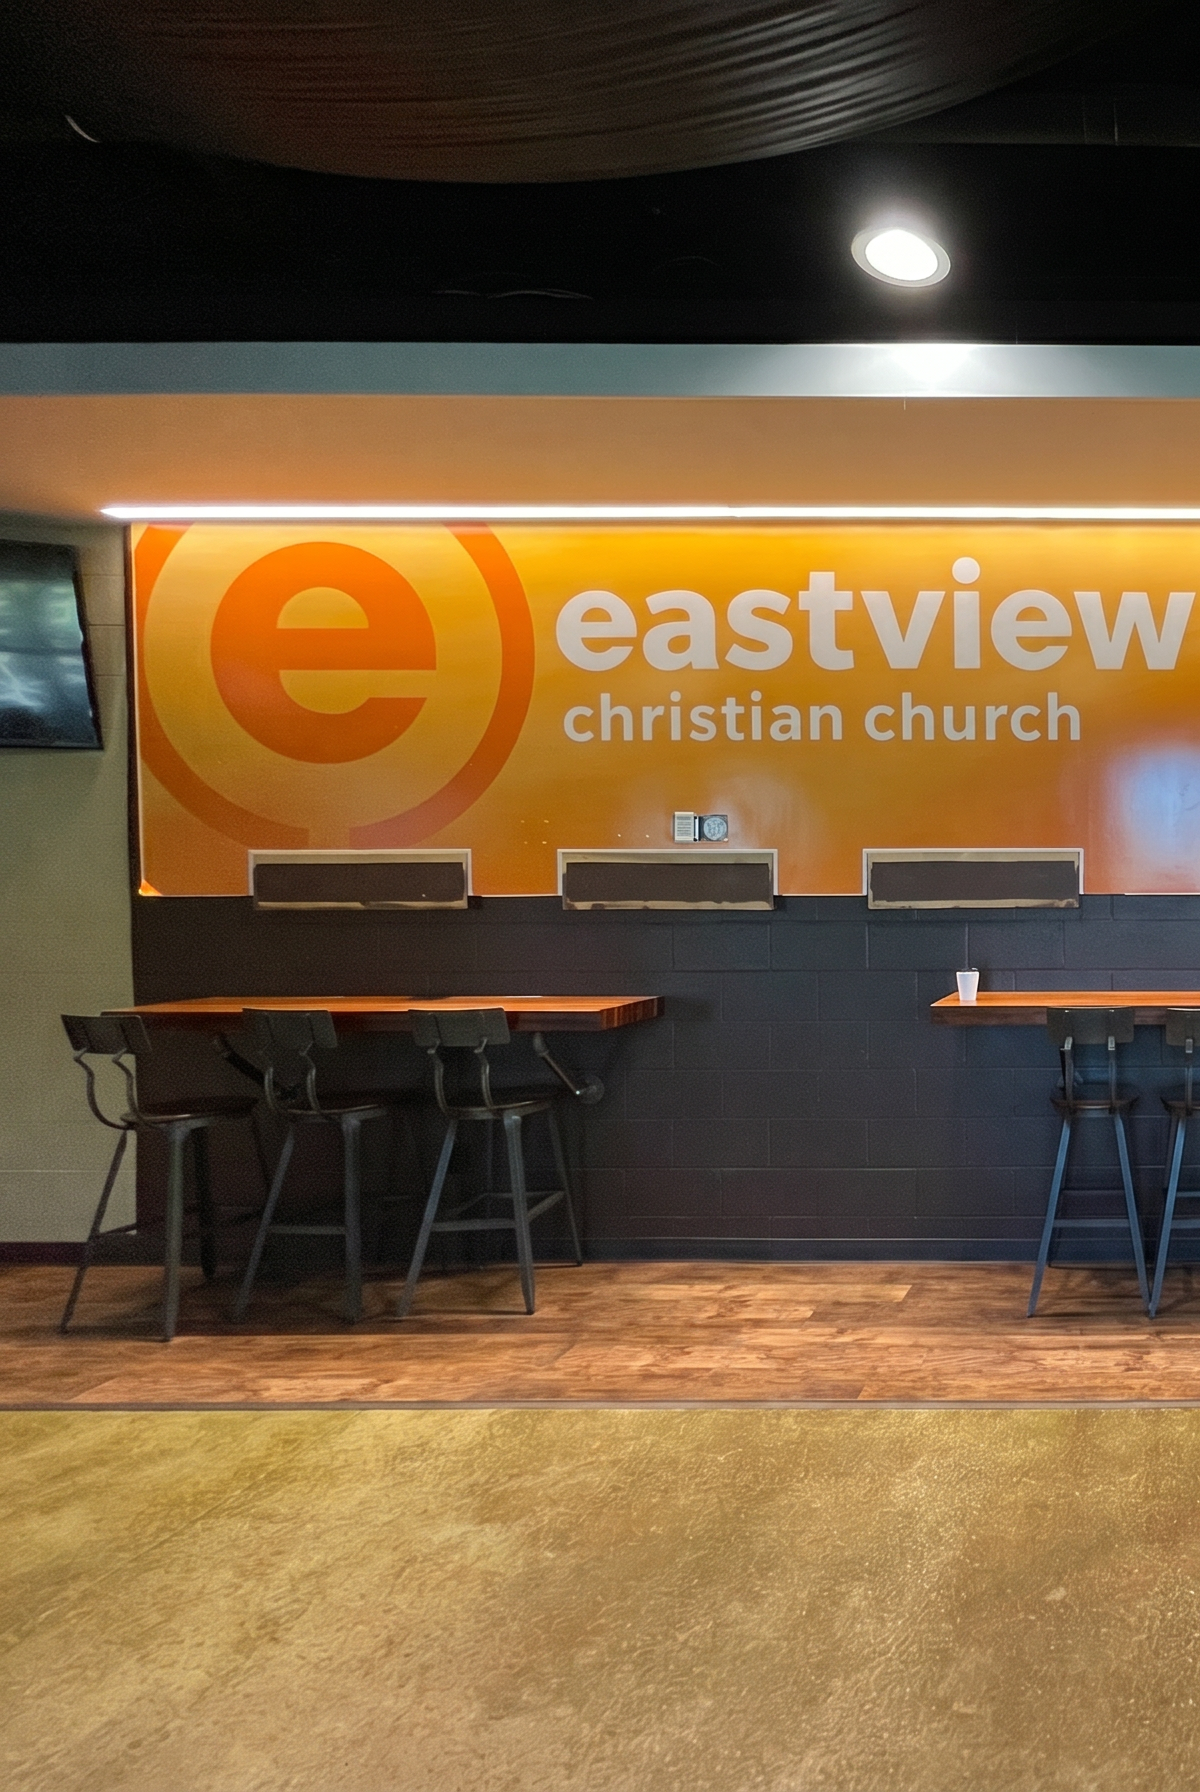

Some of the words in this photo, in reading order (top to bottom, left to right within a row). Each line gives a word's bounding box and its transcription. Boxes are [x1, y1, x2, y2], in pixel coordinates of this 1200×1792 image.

[211, 541, 437, 764] e
[555, 556, 1196, 672] eastview
[562, 690, 842, 744] christian
[863, 690, 1082, 743] church
